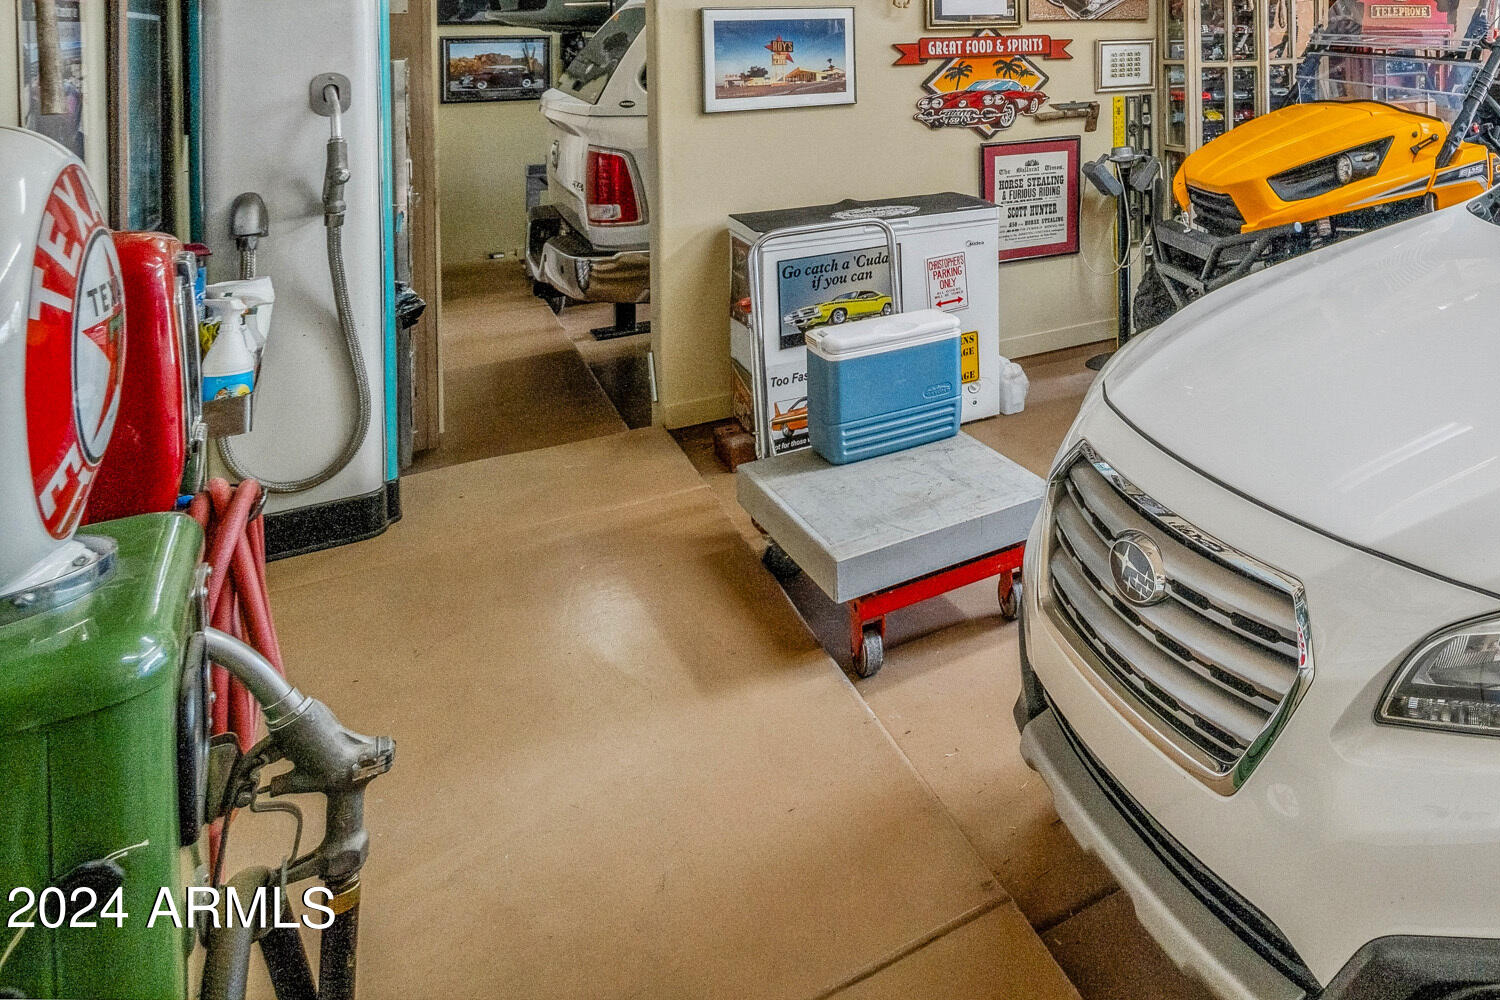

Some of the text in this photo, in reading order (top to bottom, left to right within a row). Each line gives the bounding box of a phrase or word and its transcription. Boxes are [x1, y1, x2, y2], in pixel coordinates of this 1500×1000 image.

[1375, 6, 1428, 17] TELEPHONE
[927, 37, 1044, 56] GREAT FOOD & SPIRITS
[998, 175, 1065, 191] HORSE STEALING
[1009, 187, 1037, 199] FURIOUS
[1039, 185, 1061, 197] RIDING
[1007, 203, 1058, 219] SCOTT HUNTER
[782, 253, 890, 280] Go catch a 'Cuda
[932, 266, 963, 280] PARKING
[811, 269, 873, 291] if you can
[939, 277, 957, 290] ONLY
[771, 372, 808, 388] Too Fas
[782, 441, 791, 449] for
